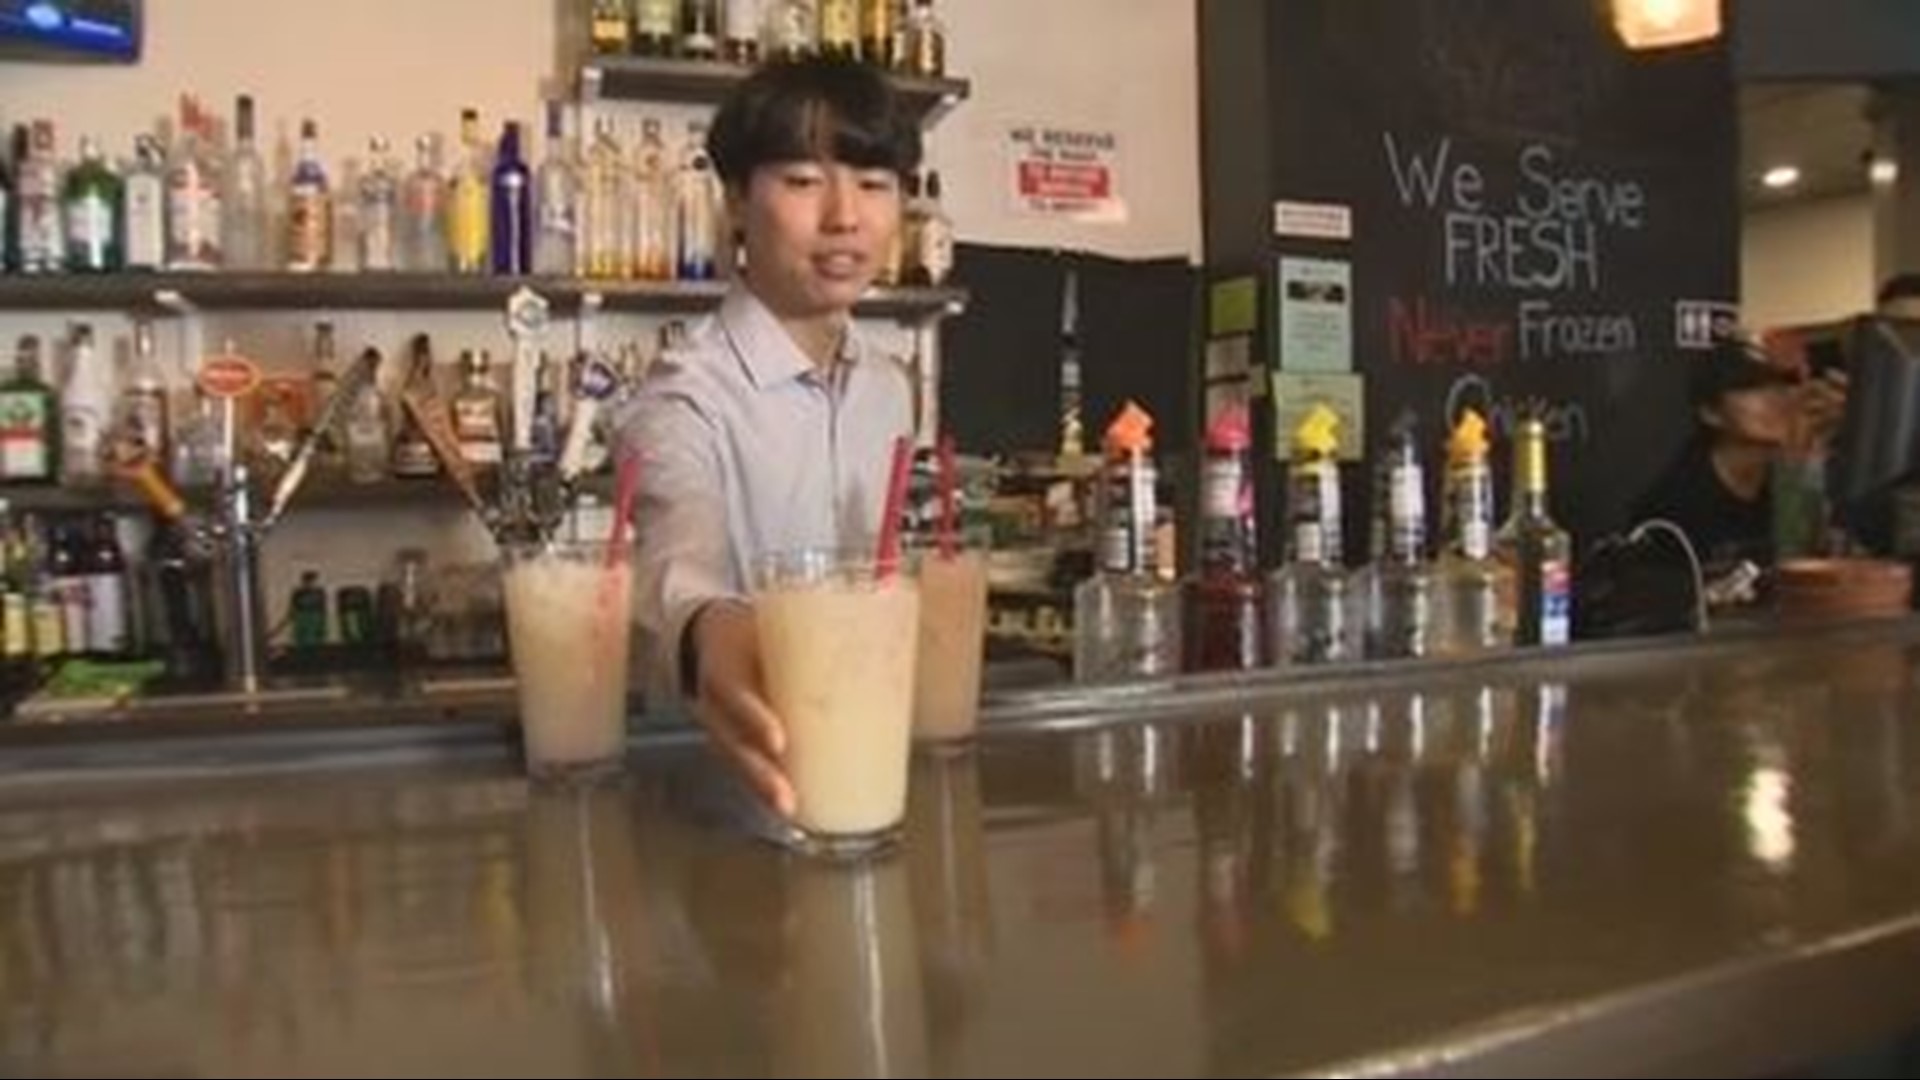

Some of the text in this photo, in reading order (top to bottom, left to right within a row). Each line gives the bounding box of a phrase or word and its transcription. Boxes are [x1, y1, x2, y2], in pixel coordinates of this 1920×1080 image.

[1384, 131, 1645, 228] We Serve
[1445, 212, 1598, 290] FRESH
[1387, 298, 1511, 363] Never
[1519, 301, 1636, 359] Frozen
[1446, 373, 1590, 442] Ciken
